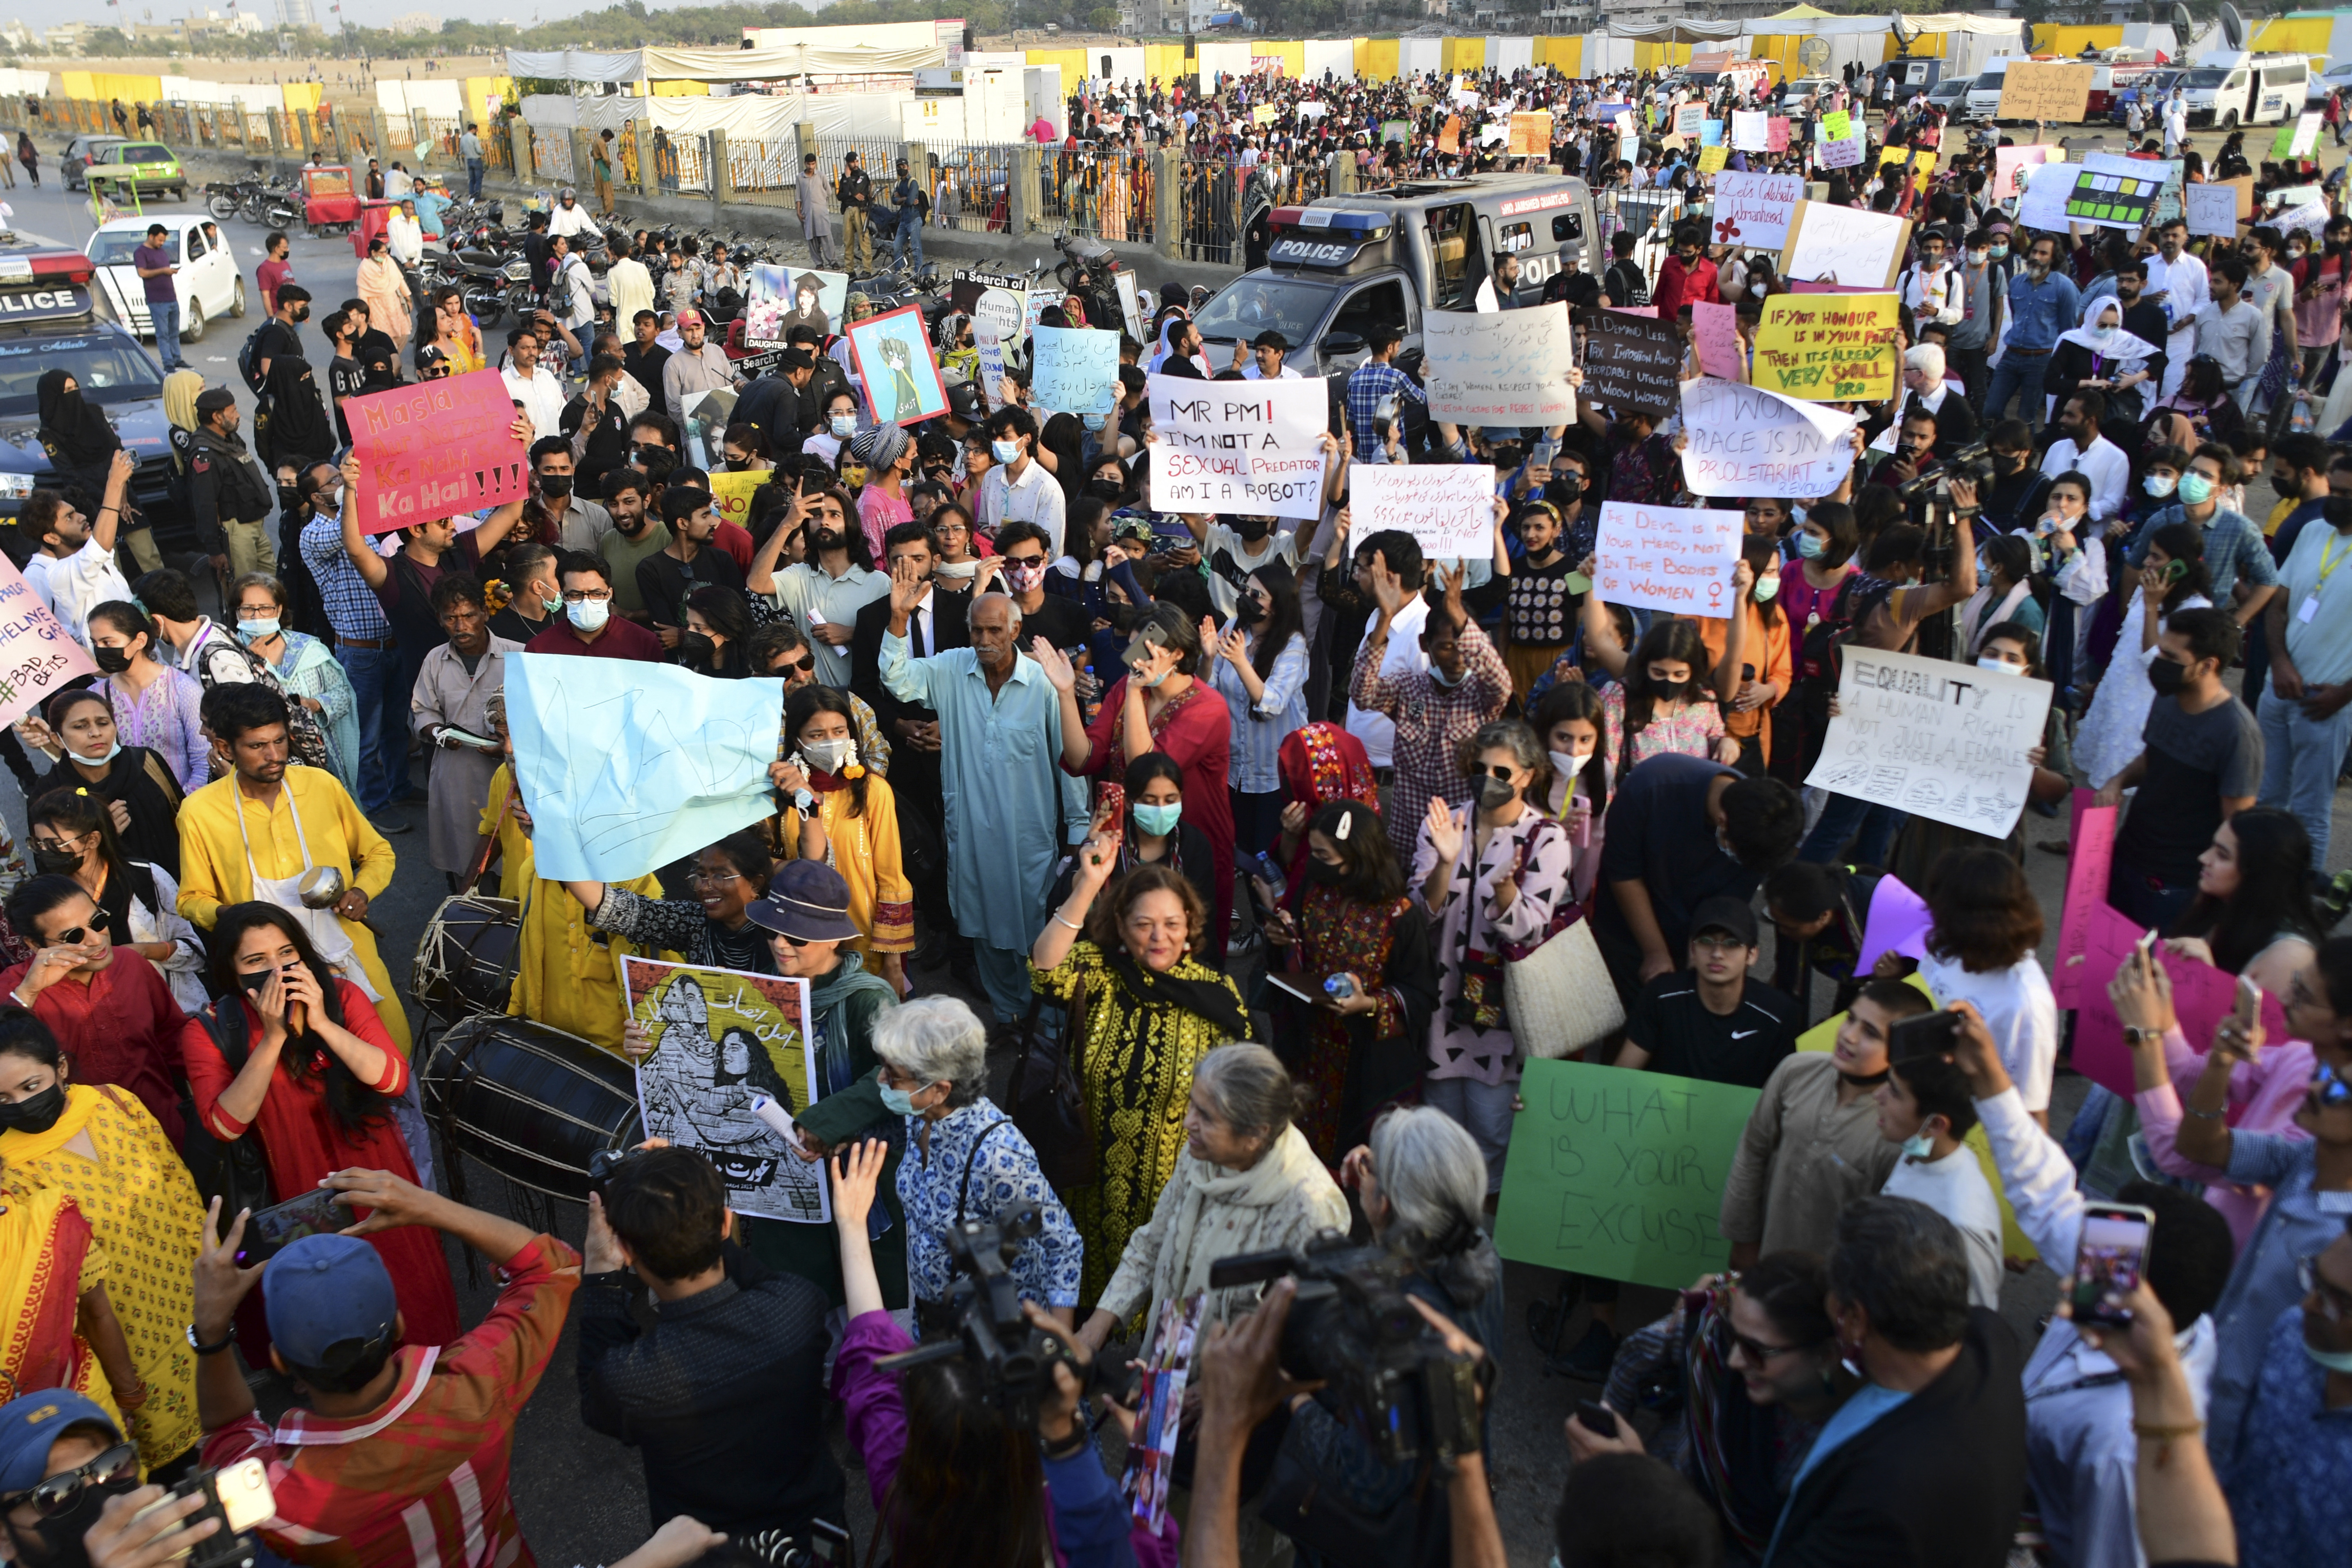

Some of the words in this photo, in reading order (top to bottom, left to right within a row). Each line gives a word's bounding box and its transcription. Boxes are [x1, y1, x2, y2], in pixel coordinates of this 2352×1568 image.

[2013, 66, 2028, 81] You
[2032, 65, 2049, 80] Son
[2054, 67, 2069, 81] Of
[2075, 71, 2084, 83] A
[2004, 92, 2031, 112] Strong
[1719, 176, 1754, 199] Let's
[1515, 198, 1540, 213] JAMSHED
[1731, 200, 1784, 226] Womanhood
[1277, 241, 1347, 260] POLICE
[954, 269, 965, 280] In
[968, 272, 1008, 287] Search
[1012, 279, 1024, 290] of
[979, 299, 1019, 315] Human
[1771, 309, 1785, 325] IF
[1784, 310, 1815, 326] YOUR
[1823, 311, 1877, 326] HONOUR
[1586, 315, 1600, 332] I
[1603, 317, 1642, 338] DEMAND
[1646, 325, 1666, 342] LESS
[1794, 330, 1805, 343] IS
[1813, 330, 1825, 342] IN
[1825, 330, 1860, 345] YOUR
[749, 339, 788, 349] DAUGHTER
[981, 348, 1002, 357] COVER
[1588, 340, 1605, 359] TAX
[1654, 349, 1676, 366] AND
[732, 361, 741, 372] In
[743, 353, 775, 369] Search
[1760, 350, 1799, 367] THEN
[1831, 347, 1883, 361] ALREDY
[1498, 383, 1531, 391] RESPECT
[1536, 381, 1556, 392] YOUR
[1582, 362, 1631, 380] AFFORDABLE
[1637, 372, 1674, 387] UTILITIES
[1777, 365, 1825, 389] VERY
[1825, 362, 1889, 385] SMALL
[1578, 379, 1595, 397] FOR
[1599, 380, 1631, 400] WIDOW
[1635, 389, 1670, 407] WOMEN
[362, 386, 453, 435] Masla
[897, 397, 916, 414] آزادی
[1171, 399, 1212, 423] MR
[1540, 401, 1566, 413] WOMEN
[420, 411, 500, 449] Nazar
[1164, 431, 1206, 448] I'M
[1212, 433, 1253, 449] NOT
[1262, 432, 1280, 449] A
[1693, 428, 1756, 455] PLACE
[1763, 429, 1784, 454] IS
[374, 461, 410, 489] Ka
[418, 448, 469, 479] Nahi
[1168, 454, 1247, 477] SEXUAL
[1251, 458, 1320, 474] PREDATOR
[1697, 459, 1816, 483] PROLETARIAT
[1171, 485, 1194, 499] AM
[1199, 483, 1211, 499] I
[1221, 483, 1232, 499] A
[1245, 481, 1317, 502] ROBOT?
[378, 490, 414, 519] Ka
[1606, 509, 1625, 525] THE
[1635, 510, 1682, 534] DEVIL
[1692, 525, 1704, 534] IS
[1455, 529, 1479, 539] NOT
[1604, 531, 1633, 550] YOUR
[1642, 537, 1687, 554] HEAD,
[1693, 544, 1724, 554] NOT
[1602, 555, 1619, 569] IN
[1624, 556, 1653, 572] THE
[1663, 557, 1719, 576] BODIES
[1602, 576, 1619, 591] OF
[1629, 578, 1695, 601] WOMEN
[1853, 660, 1990, 710] EQUALITY
[2005, 693, 2027, 719] IS
[1848, 691, 1862, 708] A
[1876, 696, 1945, 727] HUMAN
[1961, 713, 2015, 743] RIGHT
[1846, 717, 1881, 738] NOT
[1893, 726, 1936, 752] JUST
[1943, 737, 1957, 755] A
[1964, 741, 2029, 769] FEMALE
[1845, 740, 1870, 761] OR
[1879, 743, 1949, 769] GENDER
[1954, 760, 2006, 786] FIGHT
[707, 986, 769, 1022] انصاف
[754, 1023, 796, 1050] اصل
[1549, 1077, 1699, 1137] WHAT
[725, 1160, 772, 1182] عورت
[1550, 1135, 1585, 1177] IS
[1613, 1141, 1715, 1194] YOUR
[1556, 1191, 1724, 1260] EXCUSE
